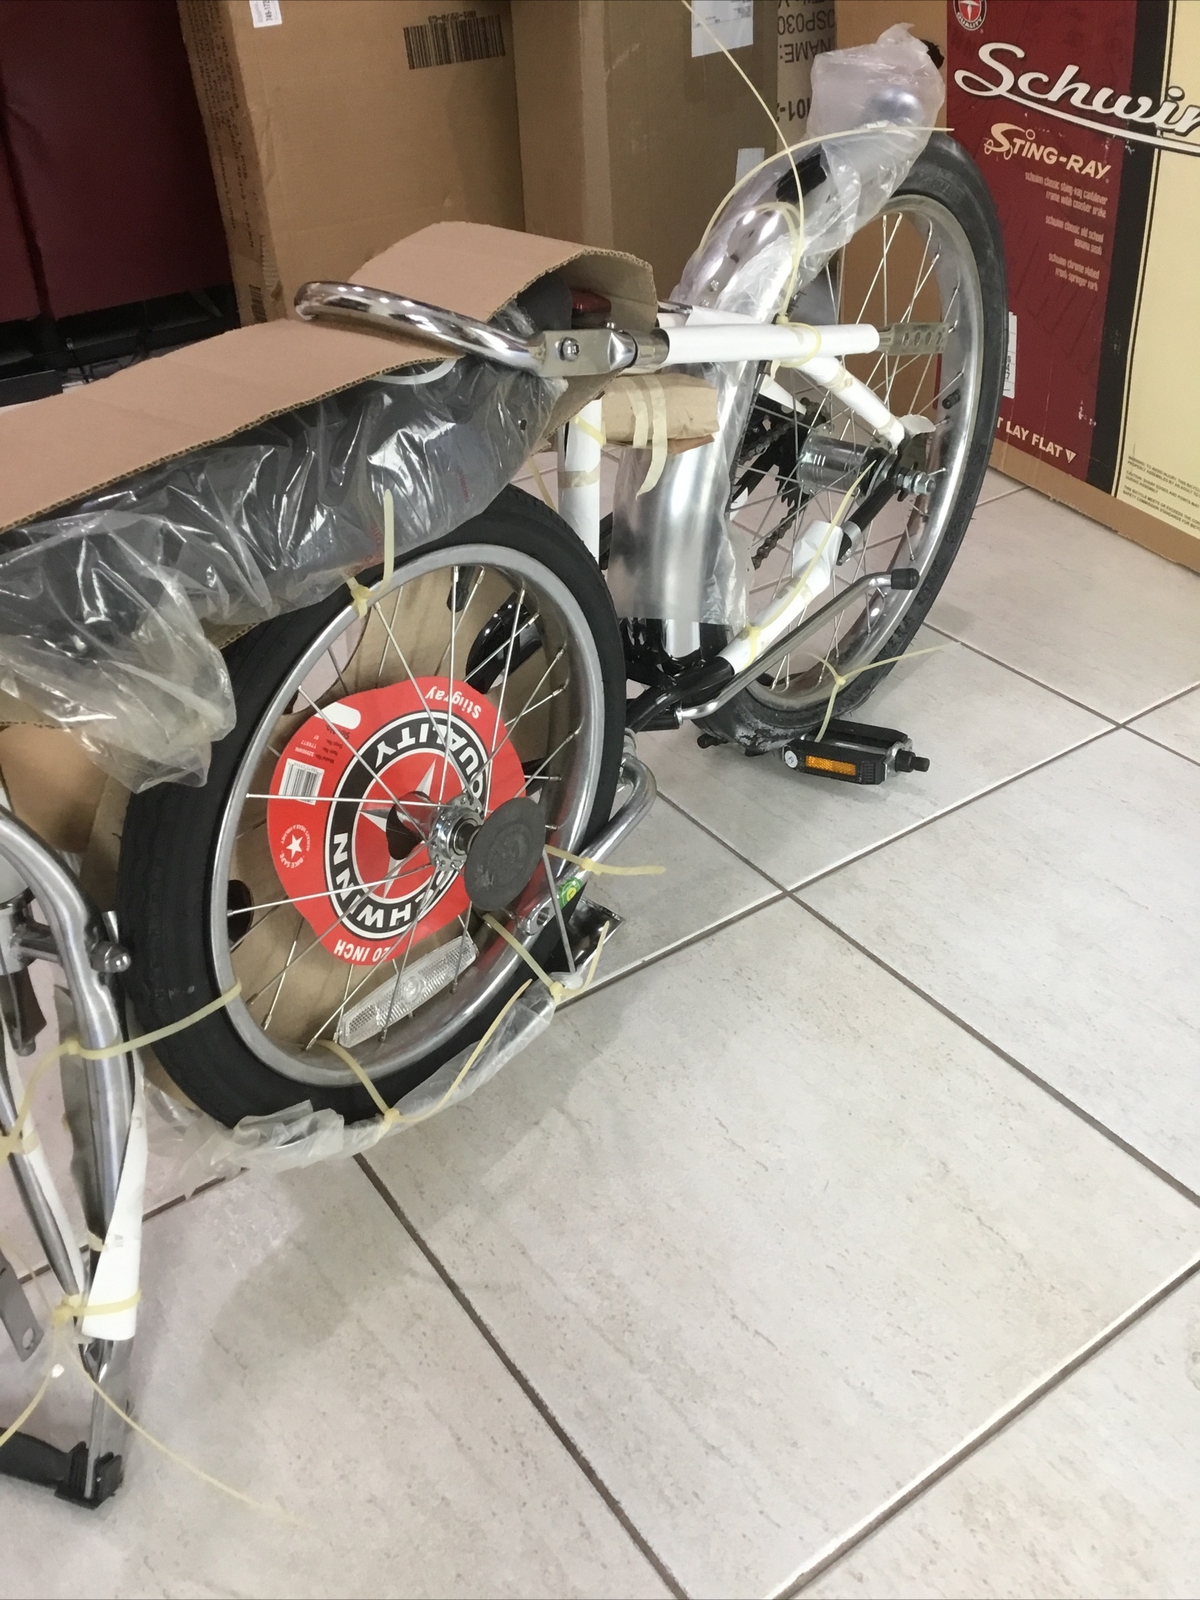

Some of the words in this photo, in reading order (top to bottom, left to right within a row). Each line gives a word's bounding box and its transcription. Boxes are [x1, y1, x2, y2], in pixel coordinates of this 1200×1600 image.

[956, 11, 982, 28] QUALITY
[780, 38, 831, 63] NAME:
[984, 123, 1111, 179] STING-RAY
[1006, 420, 1030, 440] LAY
[1032, 433, 1063, 458] FLAT
[375, 723, 483, 799] QUALITY
[334, 939, 370, 962] INCH
